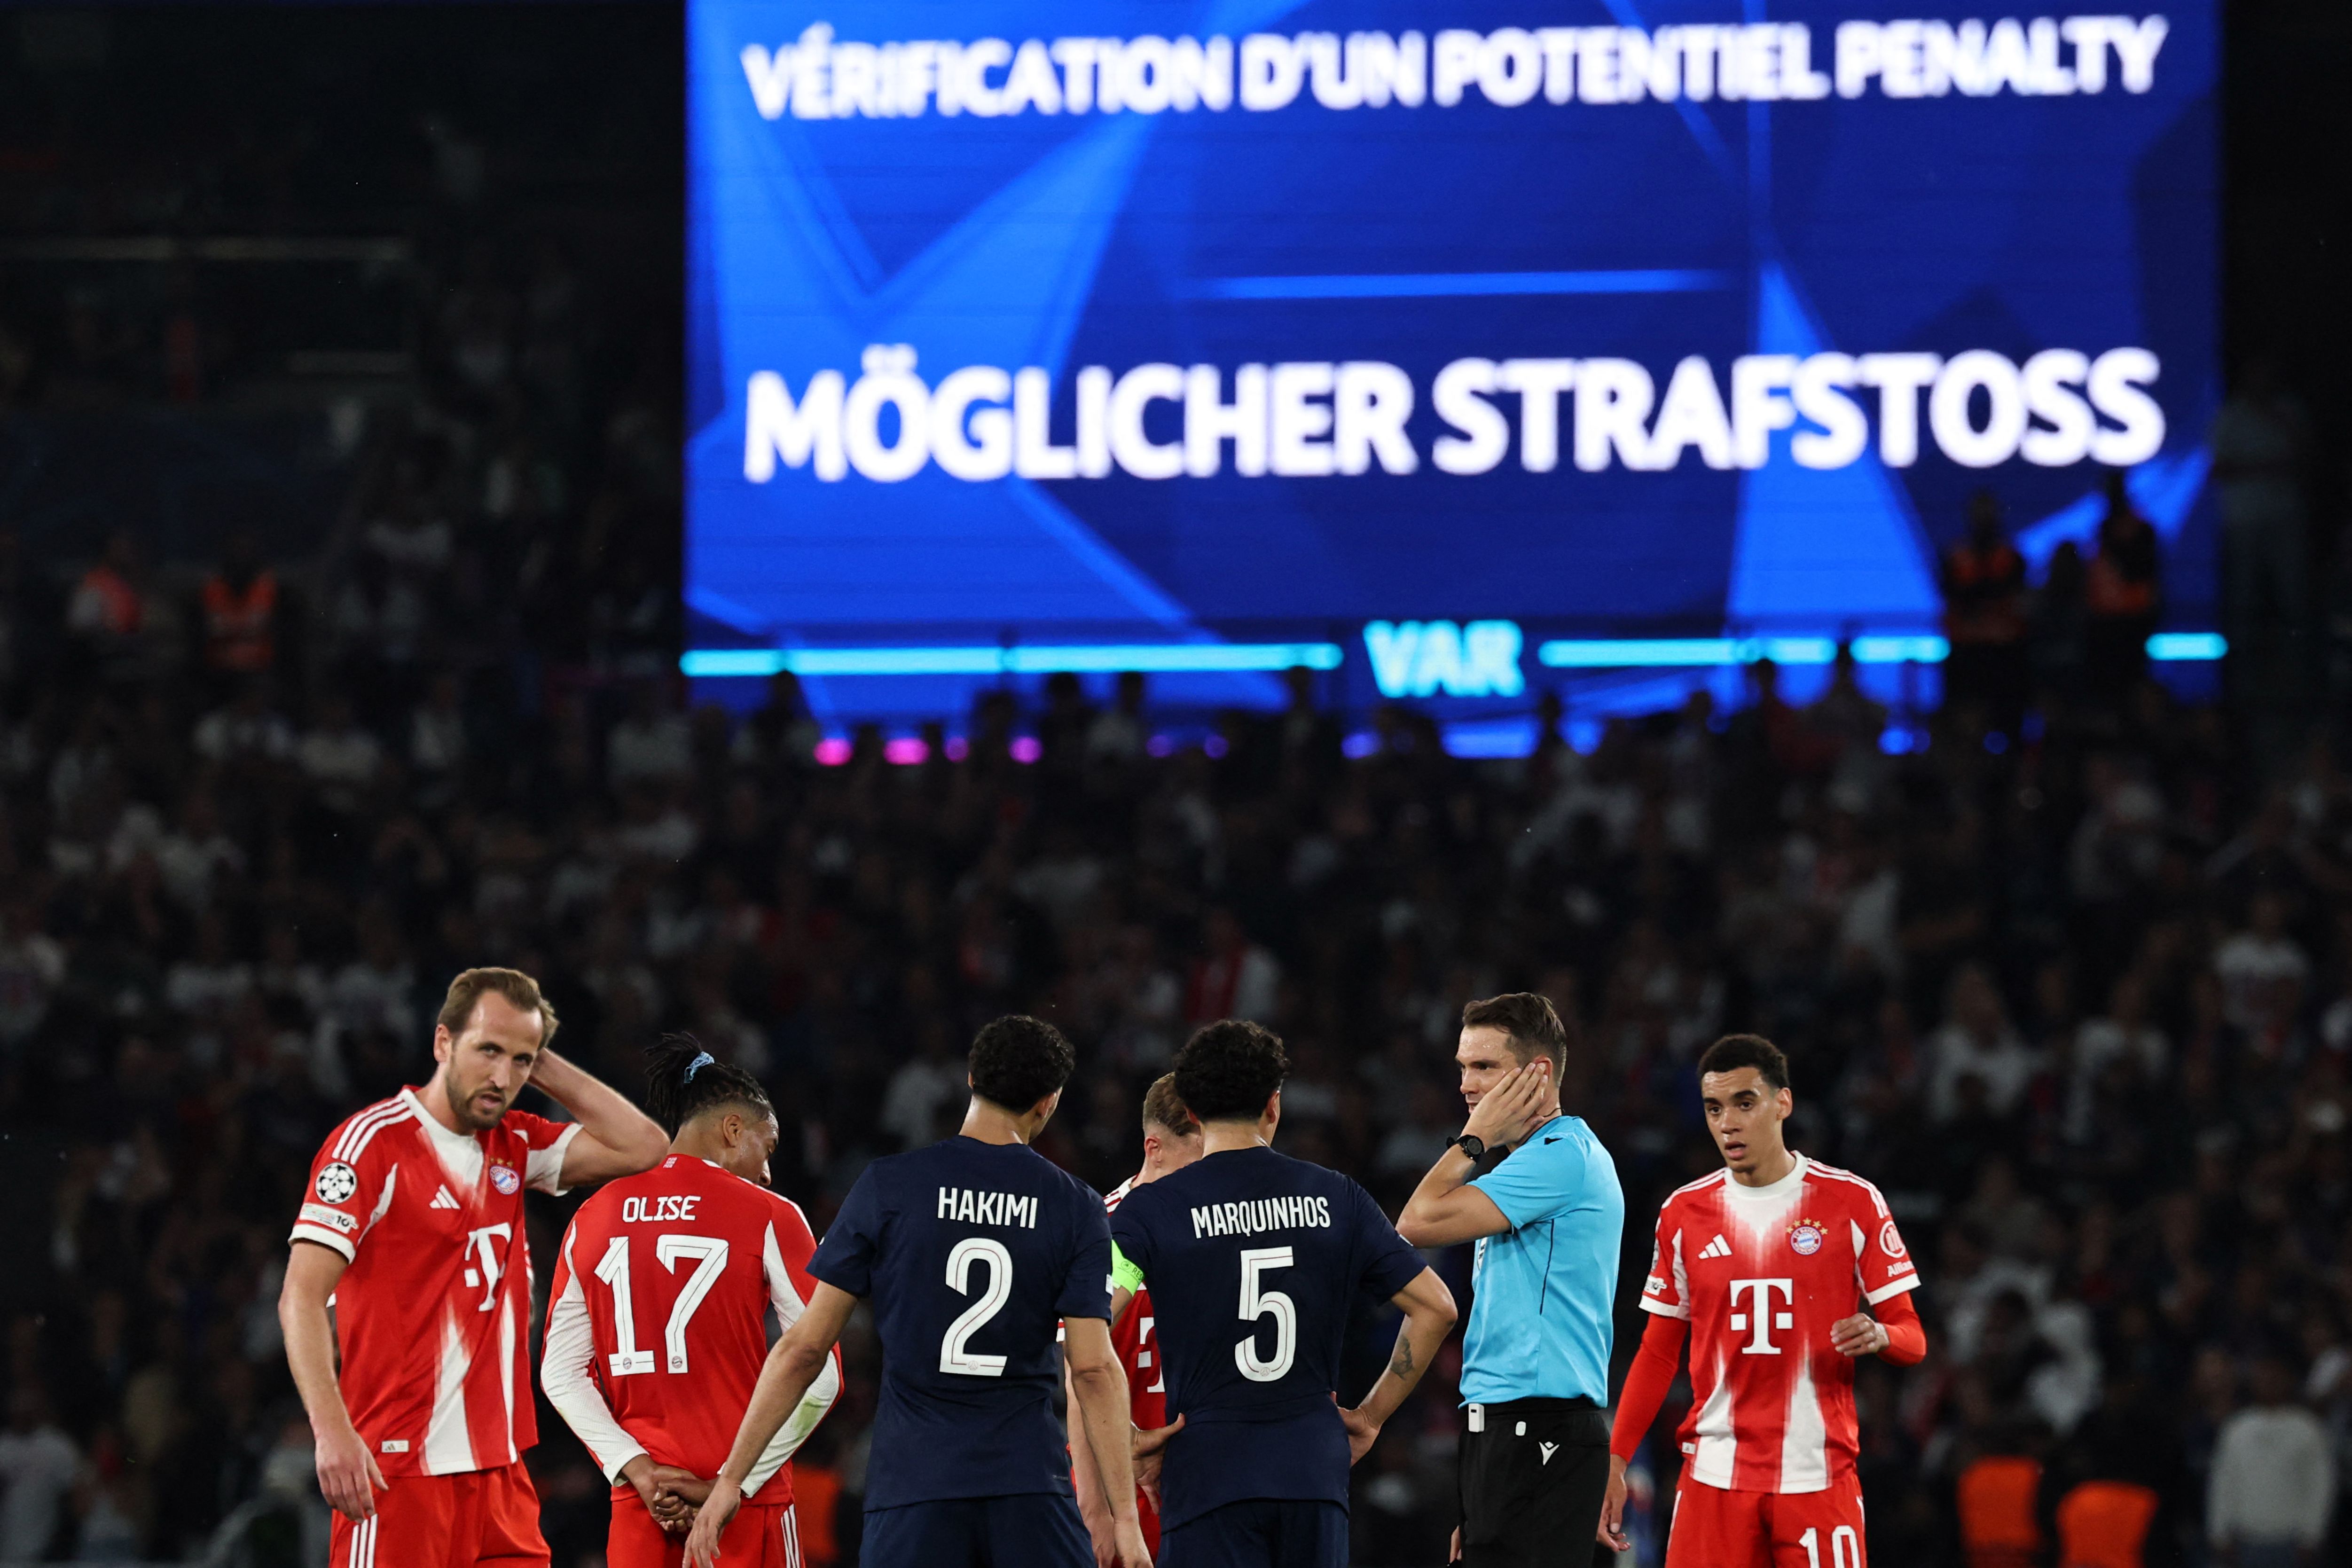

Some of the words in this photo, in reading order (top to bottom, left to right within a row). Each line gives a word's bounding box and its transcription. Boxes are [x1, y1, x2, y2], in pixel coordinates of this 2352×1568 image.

[741, 22, 1233, 119] VÉRIFICATION
[1240, 31, 1427, 111] D'UN
[1433, 23, 1831, 107] POTENTIEL
[1835, 16, 2168, 98] PENALTY
[744, 344, 1418, 483] MÖGLICHER
[1432, 347, 2165, 475] STRAFSTOSS
[1364, 620, 1525, 698] VAR
[622, 1195, 701, 1223] OLISE
[938, 1187, 1038, 1229] HAKIMI
[1191, 1196, 1331, 1239] MARQUINHOS
[594, 1234, 729, 1377] 17
[939, 1238, 1013, 1376] 2
[1235, 1246, 1296, 1382] 5
[1729, 1278, 1793, 1354] T
